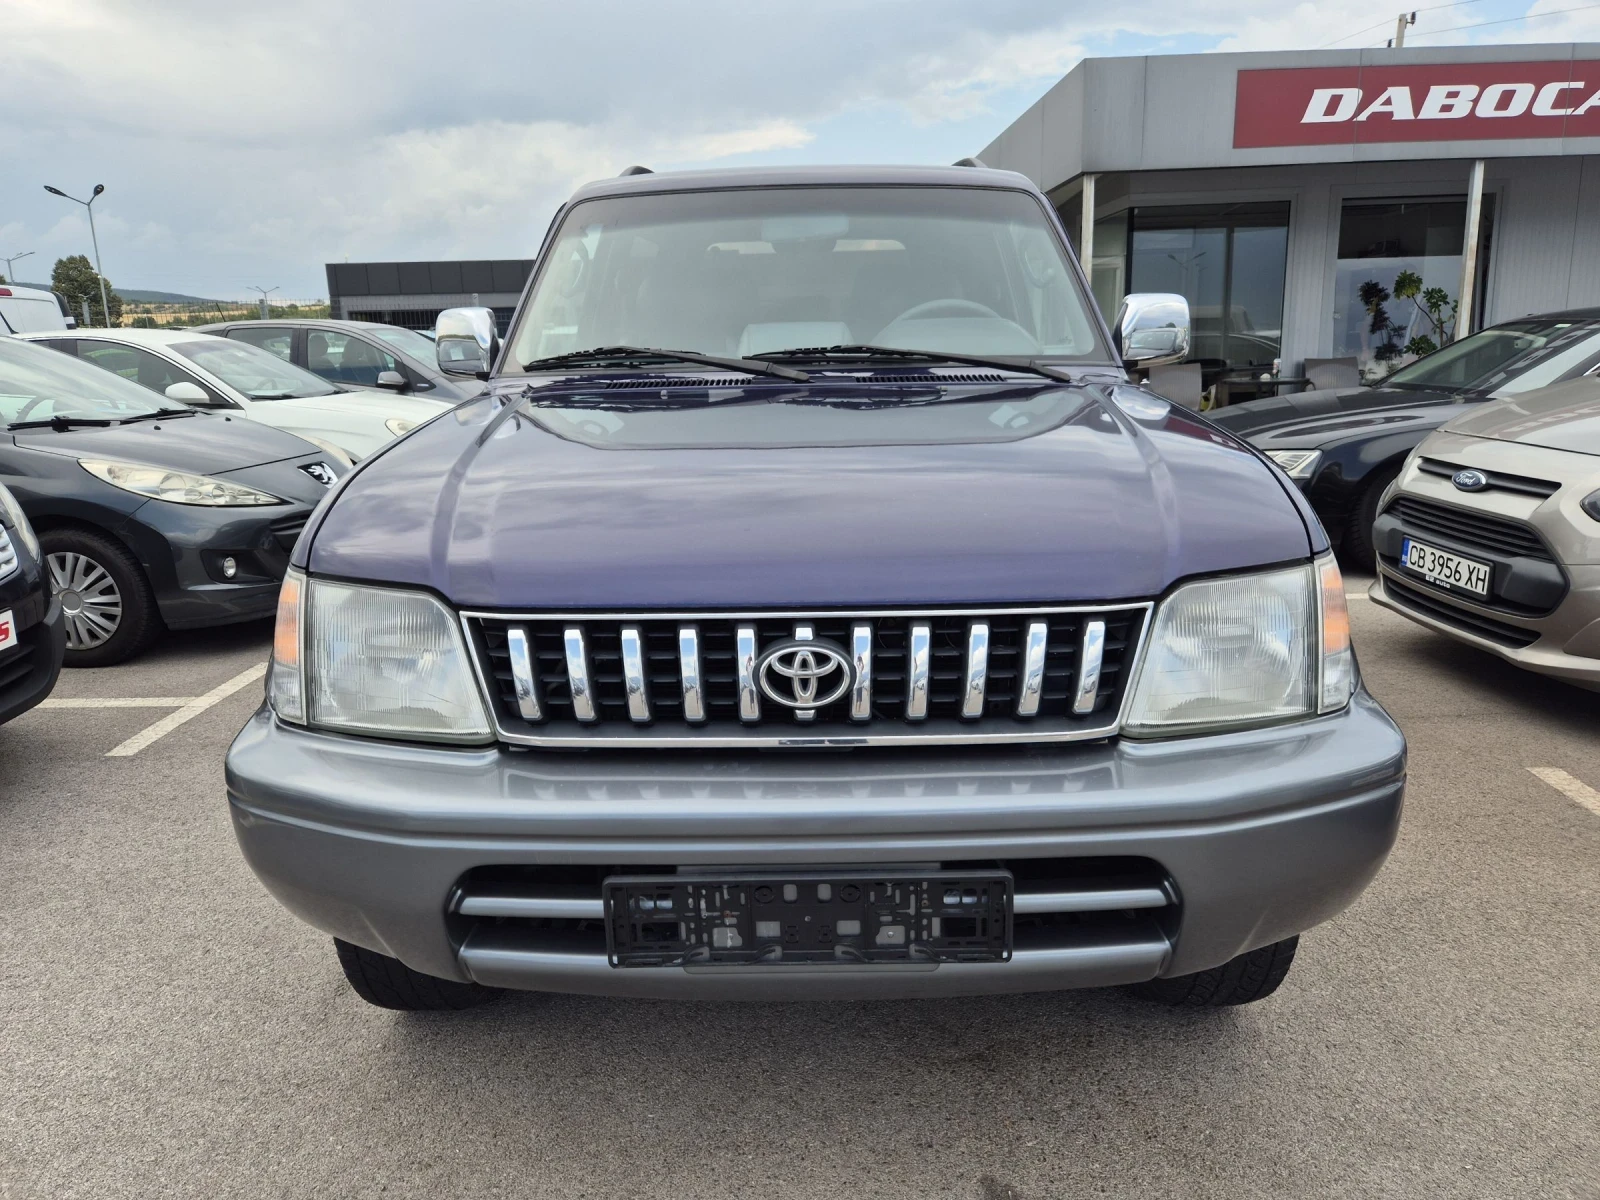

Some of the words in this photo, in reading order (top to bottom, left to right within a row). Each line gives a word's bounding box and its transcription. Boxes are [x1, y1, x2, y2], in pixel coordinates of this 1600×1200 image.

[1456, 472, 1476, 485] Ford
[1409, 545, 1426, 569] CB
[1428, 551, 1463, 583] 3956
[1464, 563, 1488, 593] XH
